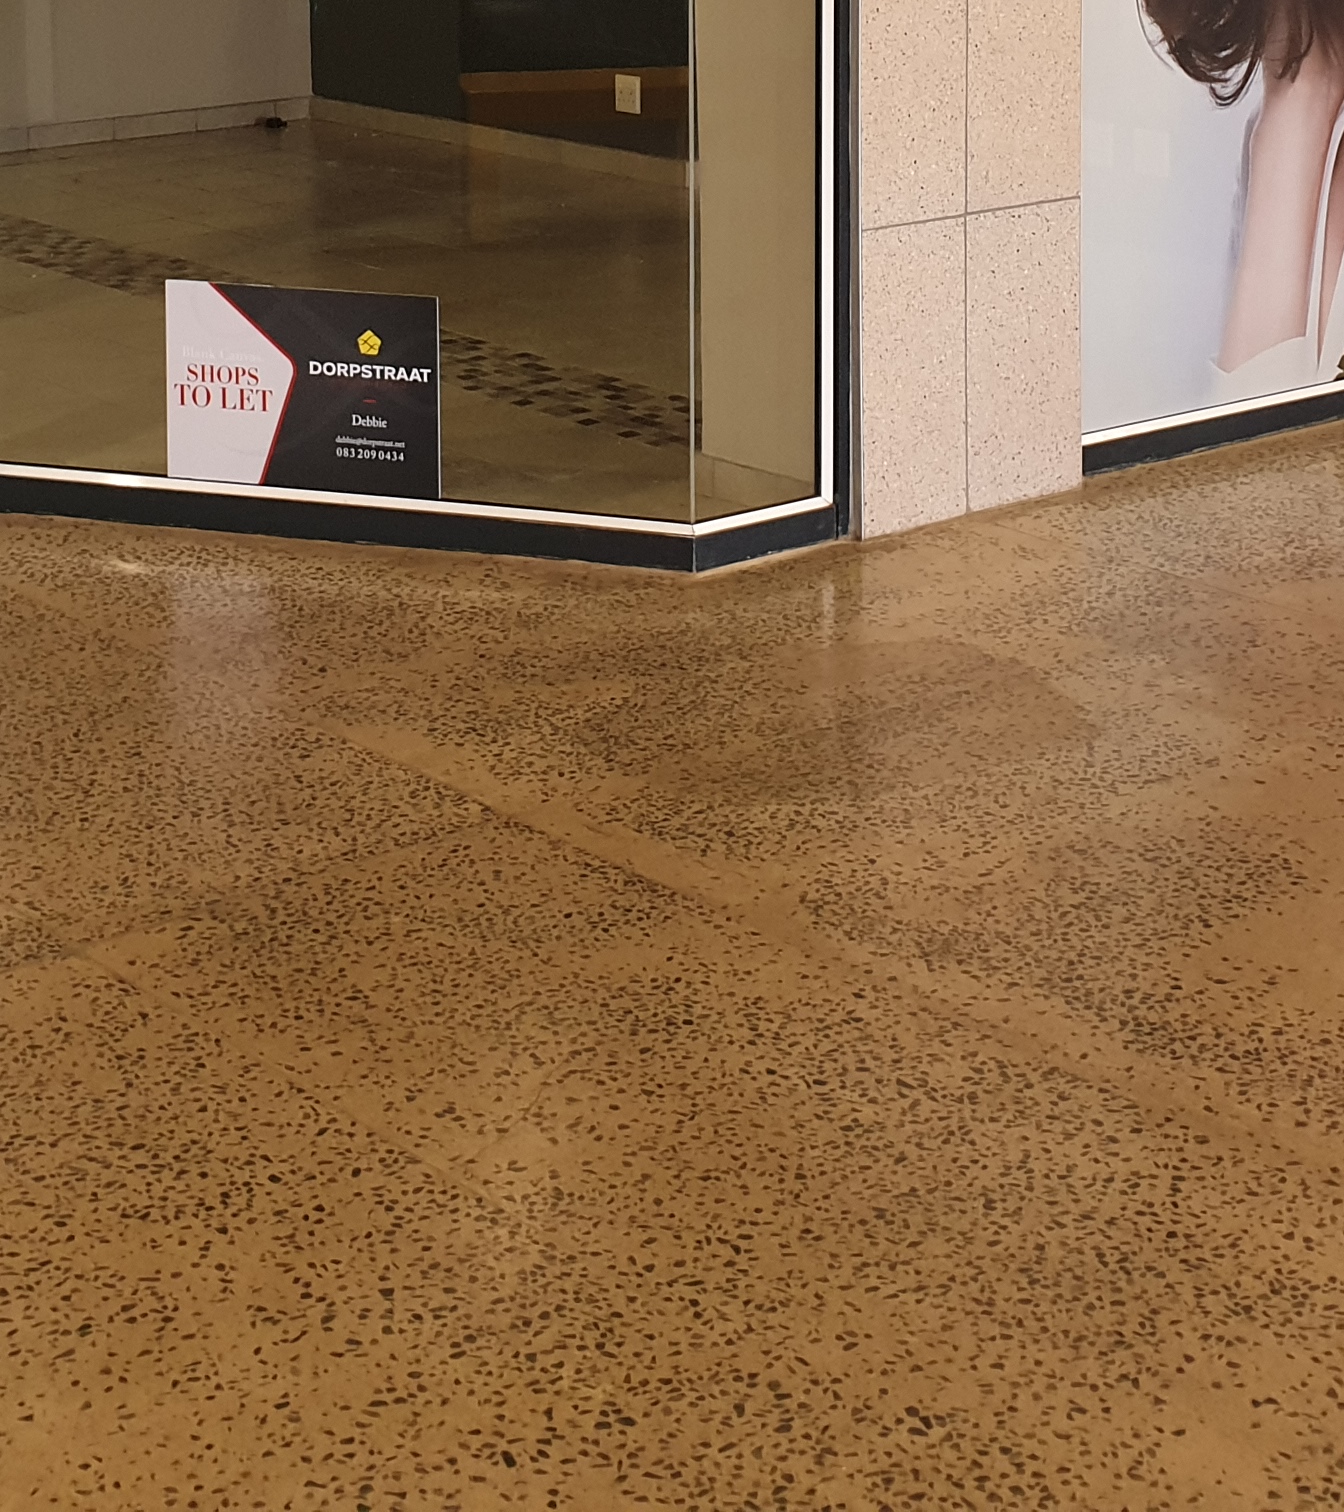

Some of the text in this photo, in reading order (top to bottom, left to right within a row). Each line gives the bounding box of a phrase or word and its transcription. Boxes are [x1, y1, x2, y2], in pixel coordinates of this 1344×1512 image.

[187, 363, 259, 386] SHOPS
[309, 361, 432, 383] DORPSTRAAT
[174, 383, 273, 412] TO LET
[352, 414, 388, 428] Debbie
